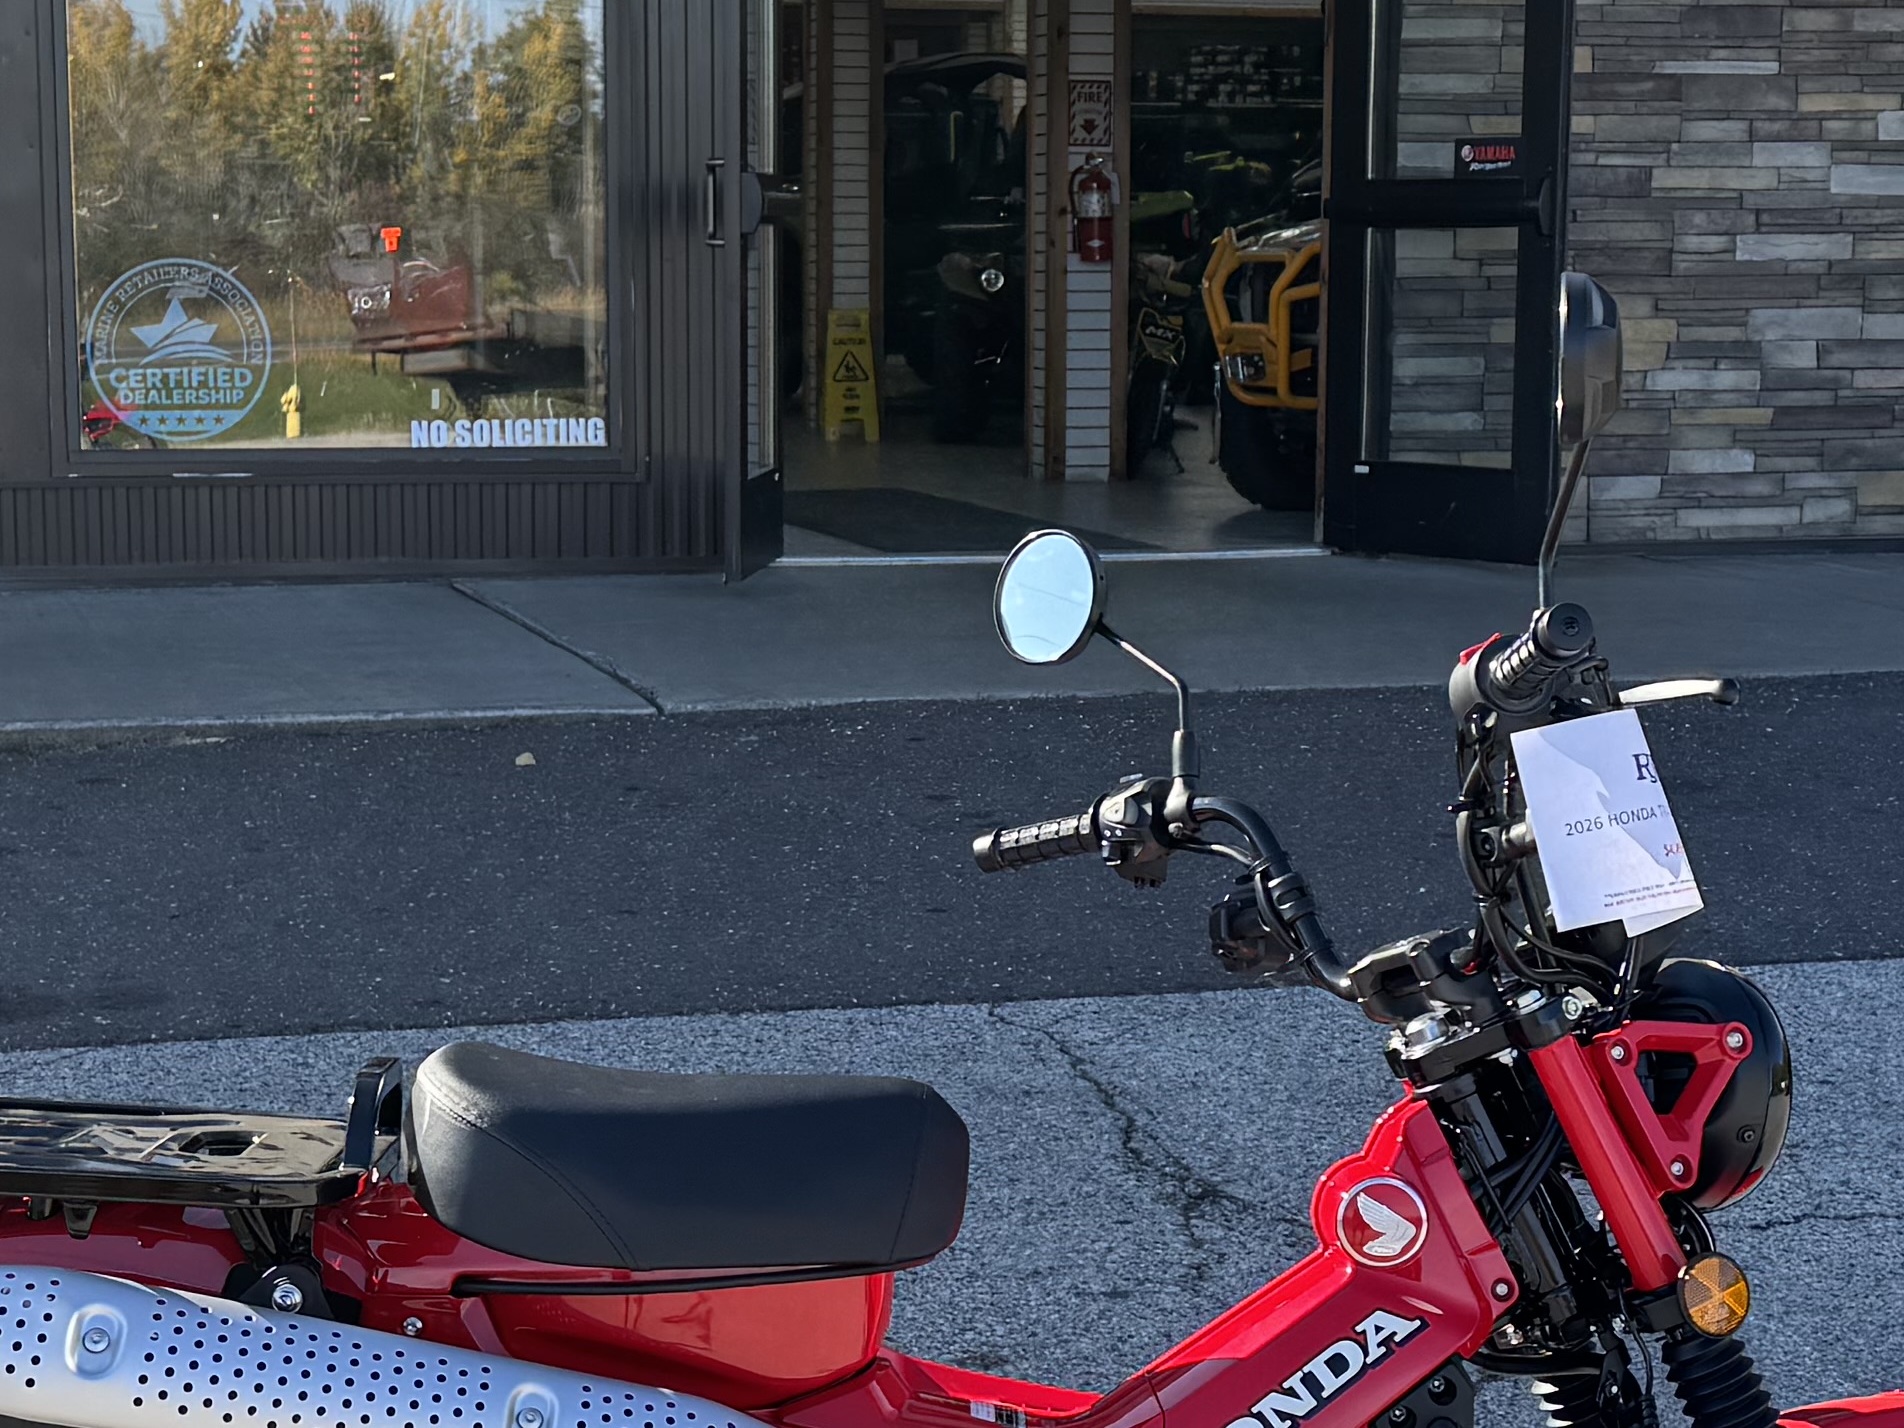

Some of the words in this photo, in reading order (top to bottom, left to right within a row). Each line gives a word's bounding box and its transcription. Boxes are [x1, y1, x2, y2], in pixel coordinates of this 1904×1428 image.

[1077, 91, 1104, 103] FIRE
[94, 301, 119, 365] MARINE
[115, 266, 199, 302] RETAILERS
[109, 367, 254, 389] CERTIFIED
[119, 389, 245, 405] DEALERSHIP
[410, 419, 448, 448] NO
[454, 417, 607, 447] SOLICITING
[1564, 816, 1604, 836] 2026
[1608, 806, 1658, 827] HONDA
